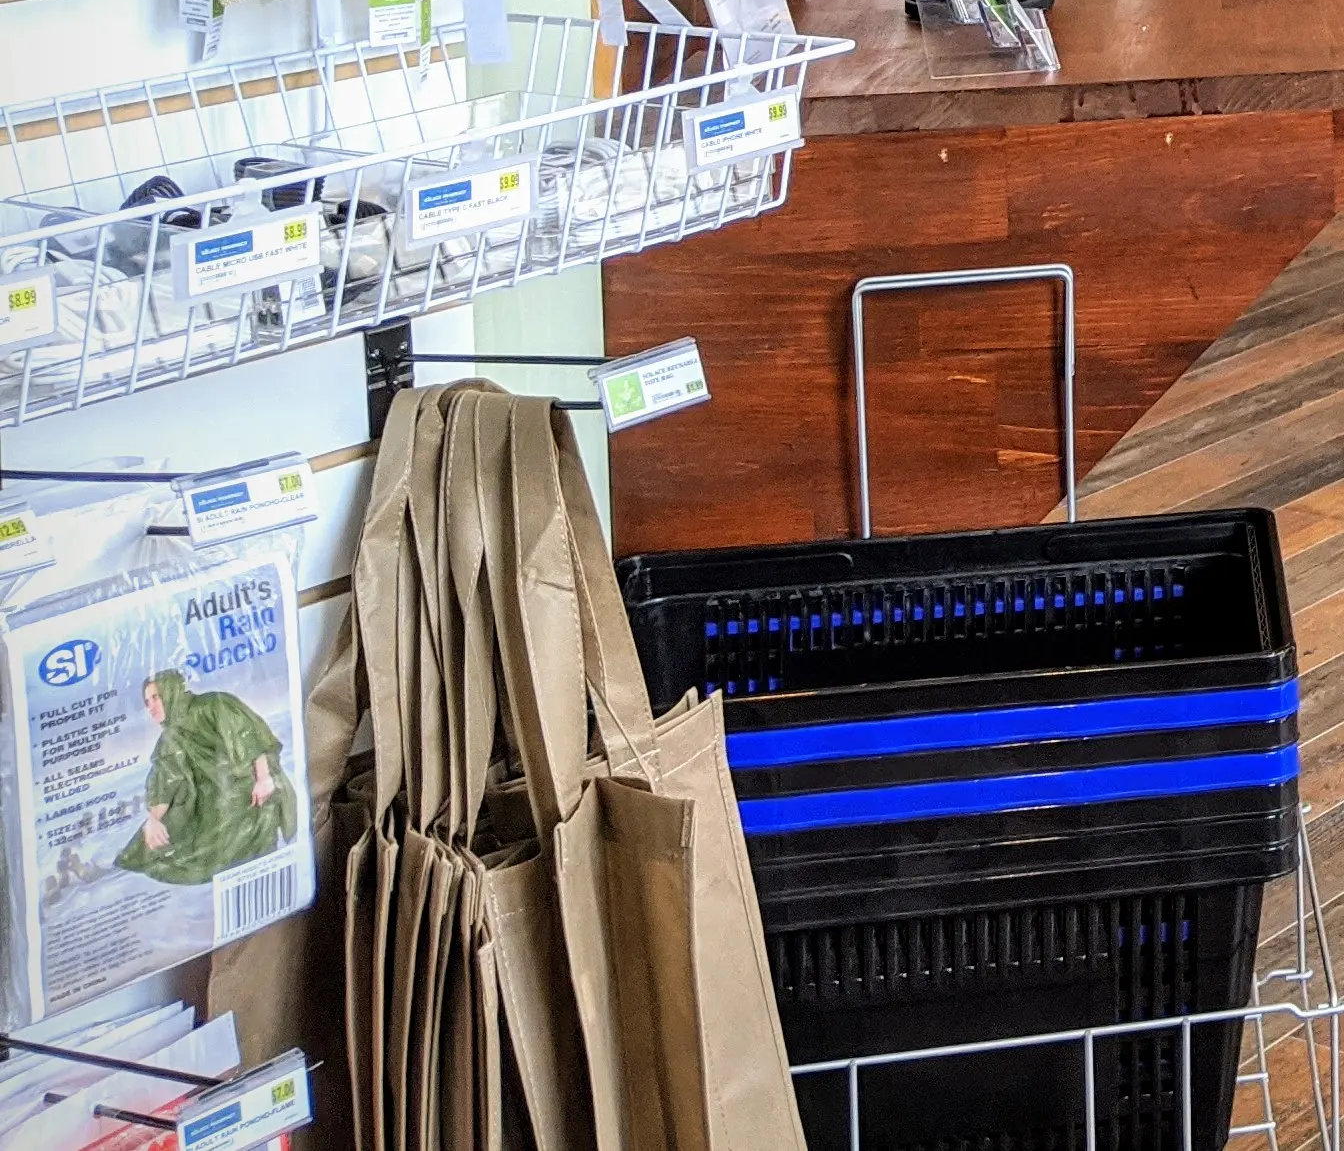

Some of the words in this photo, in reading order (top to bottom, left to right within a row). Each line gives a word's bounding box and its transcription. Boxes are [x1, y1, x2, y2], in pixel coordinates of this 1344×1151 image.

[223, 257, 246, 268] MICRO
[265, 249, 283, 258] FAST
[285, 242, 307, 253] WHITE
[8, 289, 36, 310] $8.99
[231, 505, 247, 514] RAIN
[185, 580, 272, 624] Adult's
[219, 606, 275, 641] Rain
[186, 633, 277, 681] Poncho
[40, 707, 68, 721] FULL
[71, 698, 93, 711] CUT
[97, 690, 118, 703] FOR
[41, 711, 86, 730] PROPER
[88, 704, 105, 716] FIT
[42, 728, 88, 748] PLASTIC
[91, 714, 127, 731] SNAPS
[42, 744, 65, 758] FOR
[68, 726, 120, 751] MULTIPLE
[43, 743, 101, 768] PURPOSES
[43, 772, 64, 785] ALL
[45, 805, 82, 822] LARGE
